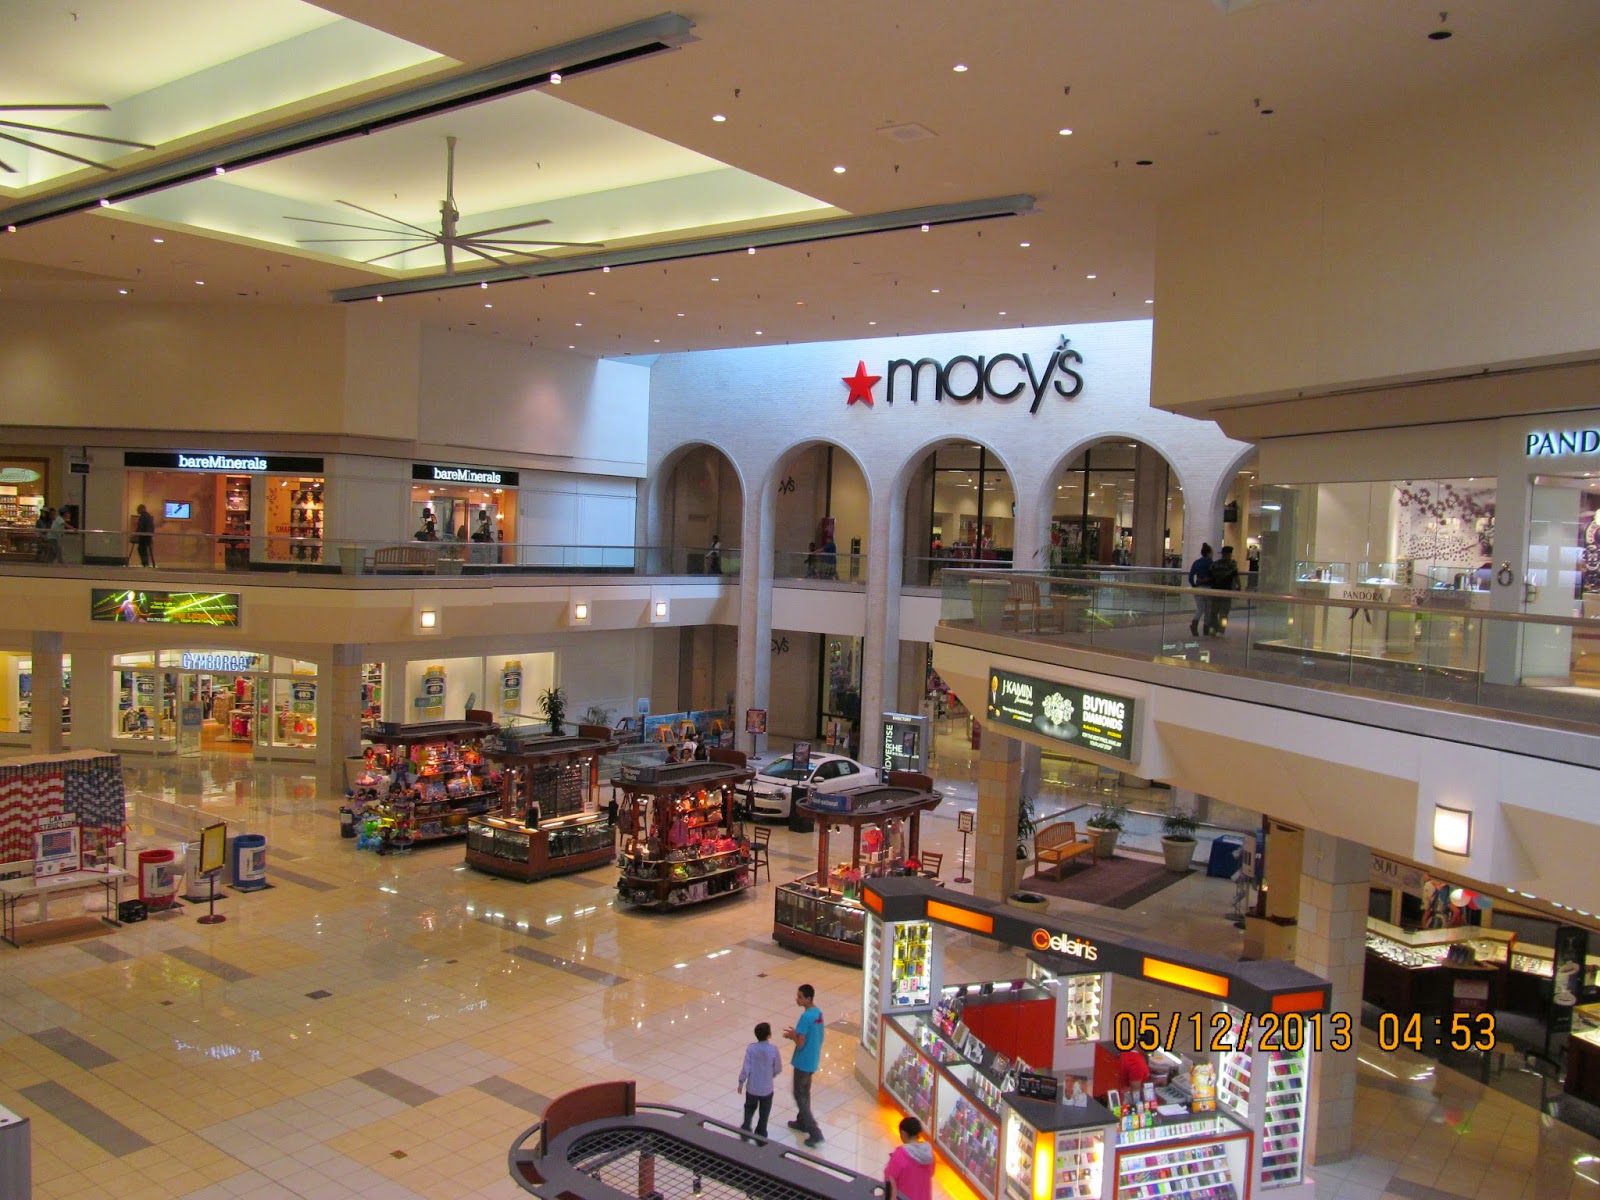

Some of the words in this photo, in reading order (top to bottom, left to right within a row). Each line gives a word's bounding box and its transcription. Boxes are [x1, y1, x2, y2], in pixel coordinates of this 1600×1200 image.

[886, 333, 1084, 414] macy's
[178, 454, 267, 470] bareMinerals
[433, 467, 501, 484] bareMinerals
[1343, 590, 1384, 601] PANDORA
[1082, 694, 1125, 719] BUYING
[1082, 710, 1123, 731] DIAMONDS
[1032, 928, 1098, 961] Cellairis
